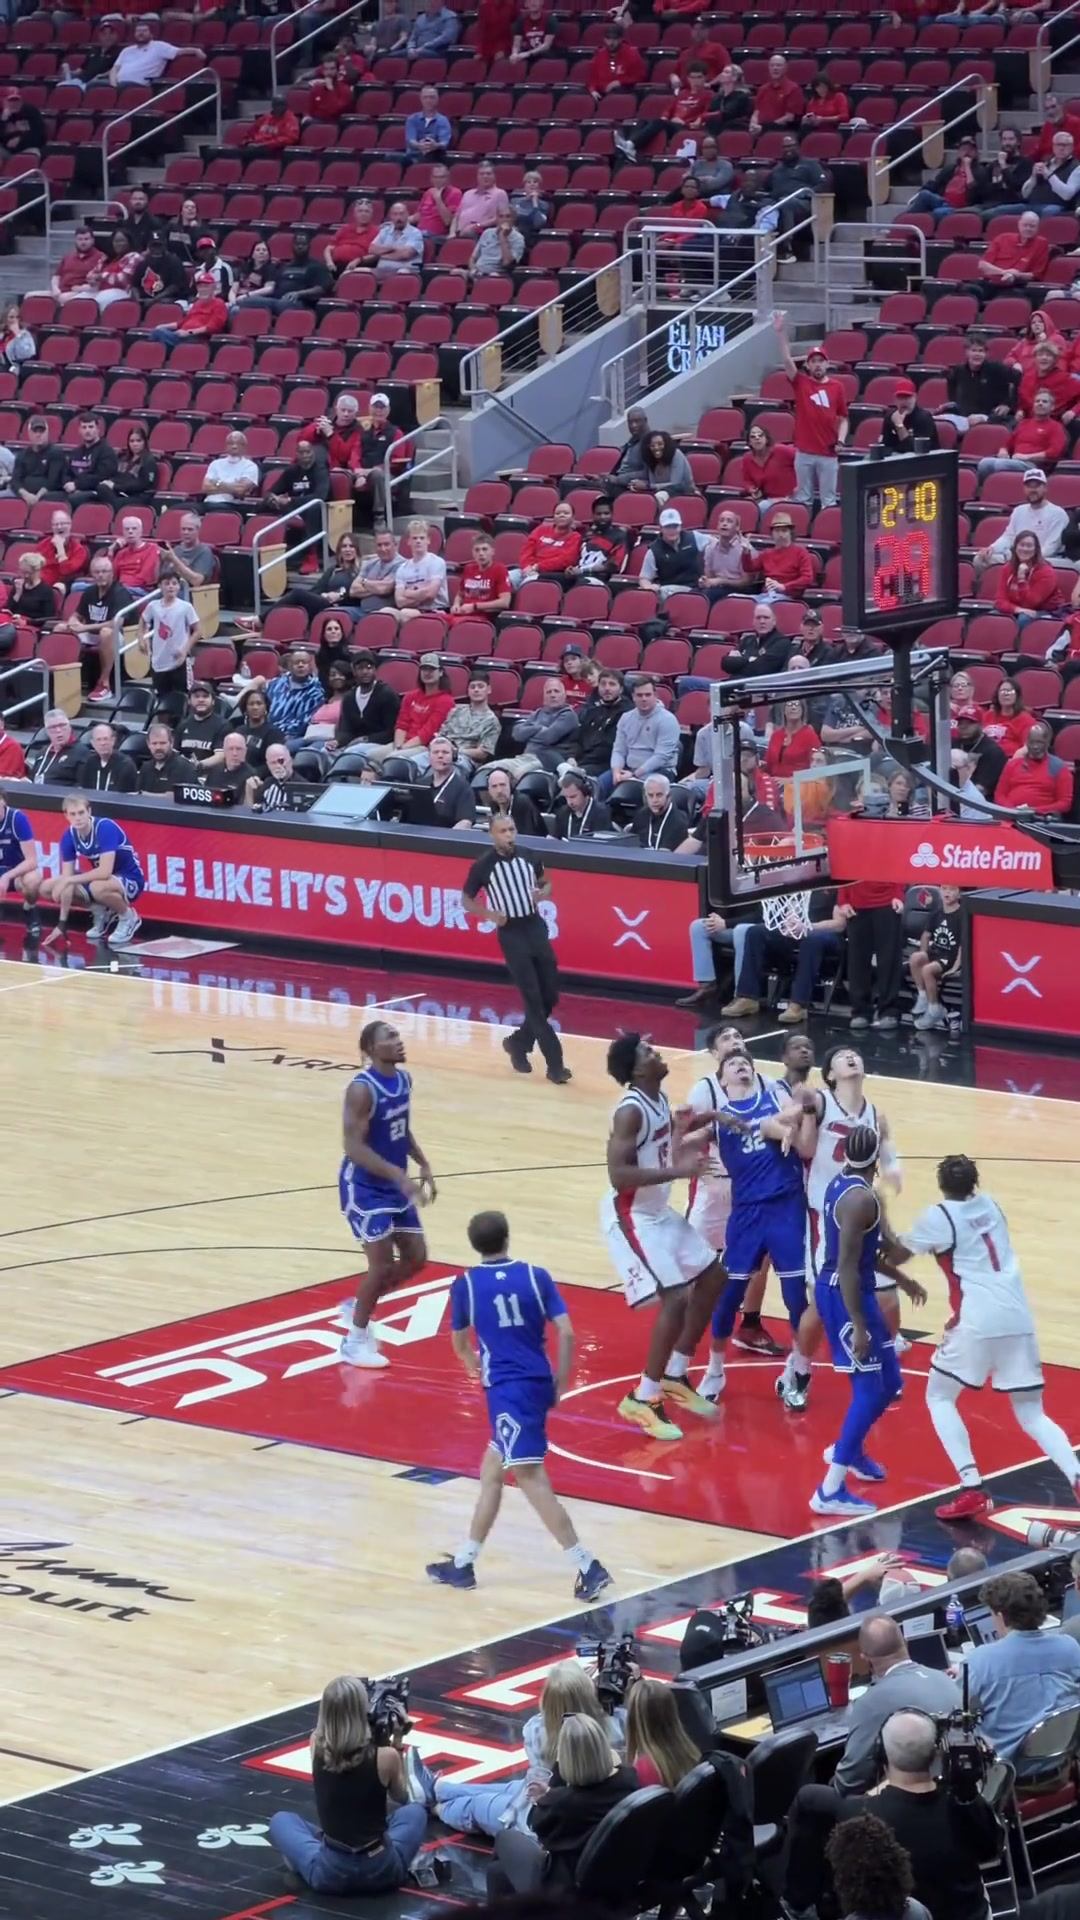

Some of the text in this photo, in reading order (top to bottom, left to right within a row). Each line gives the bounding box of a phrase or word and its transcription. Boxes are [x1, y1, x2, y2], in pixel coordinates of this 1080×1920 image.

[667, 320, 726, 351] ELJAH
[881, 481, 937, 528] 2:10
[183, 787, 212, 802] POSS
[193, 858, 273, 906] LIKE
[280, 868, 347, 916] IT'S
[354, 877, 470, 931] YOUR
[248, 1054, 363, 1071] XRP
[741, 1134, 766, 1154] 32
[981, 1232, 1001, 1272] 1
[493, 1293, 525, 1327] 11
[0, 1582, 151, 1622] ourt
